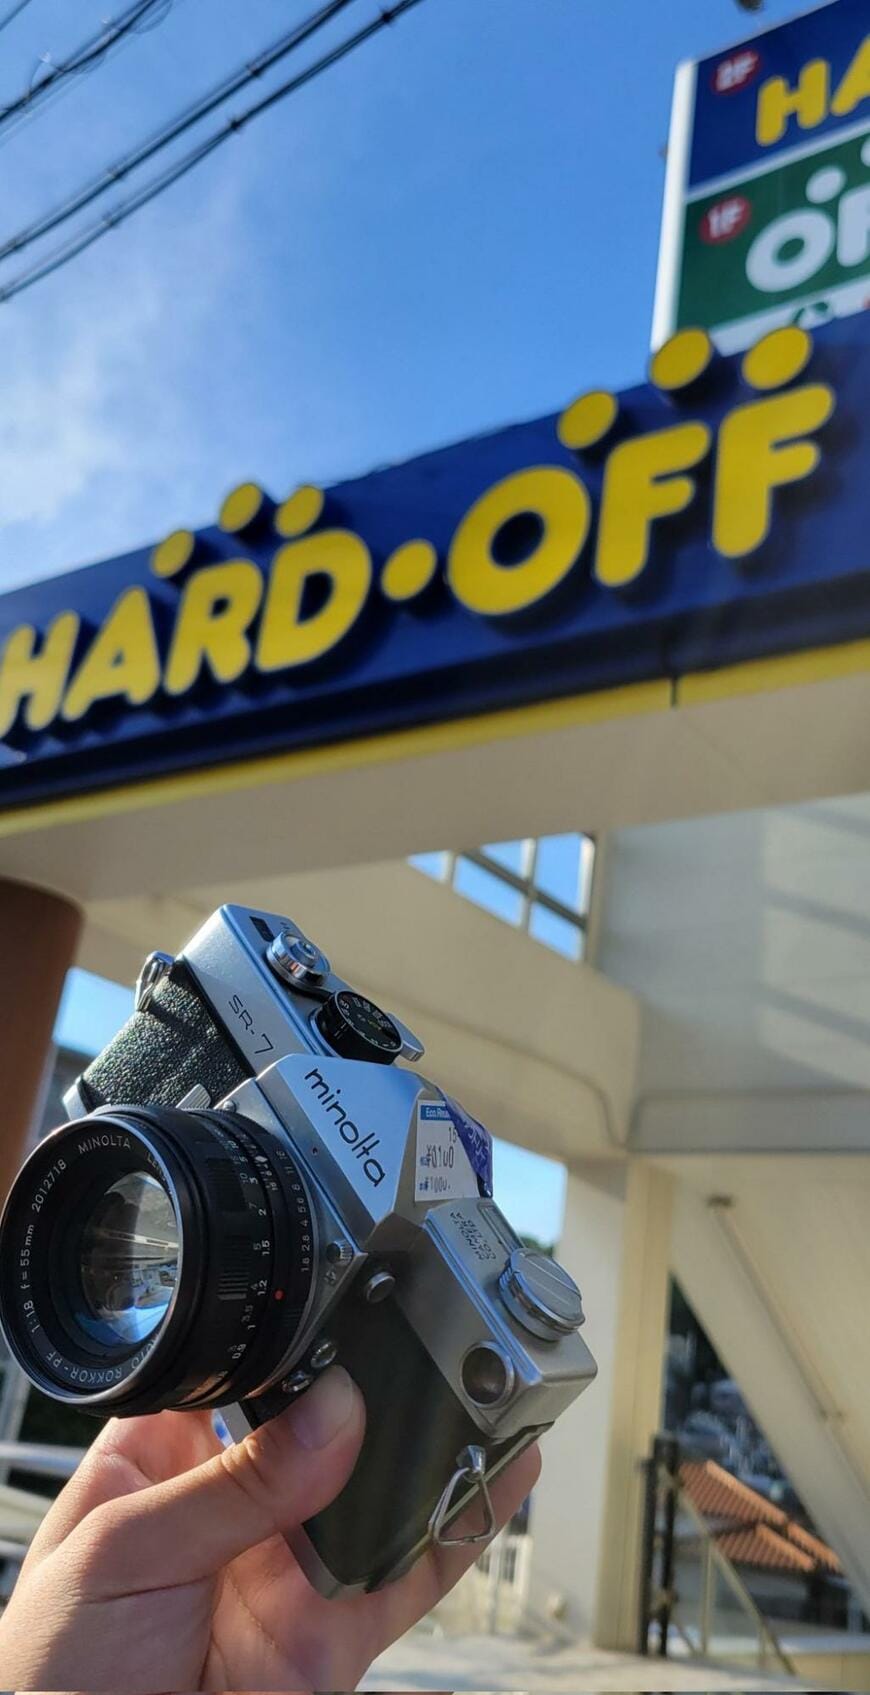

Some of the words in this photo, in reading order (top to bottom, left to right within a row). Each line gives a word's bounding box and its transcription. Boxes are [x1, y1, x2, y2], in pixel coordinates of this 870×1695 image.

[228, 994, 274, 1055] SR-7
[78, 1135, 131, 1154] MINOLTA
[304, 1068, 386, 1187] minolta
[32, 1159, 67, 1213] 2012718
[46, 1351, 122, 1384] ROKKOR-PF
